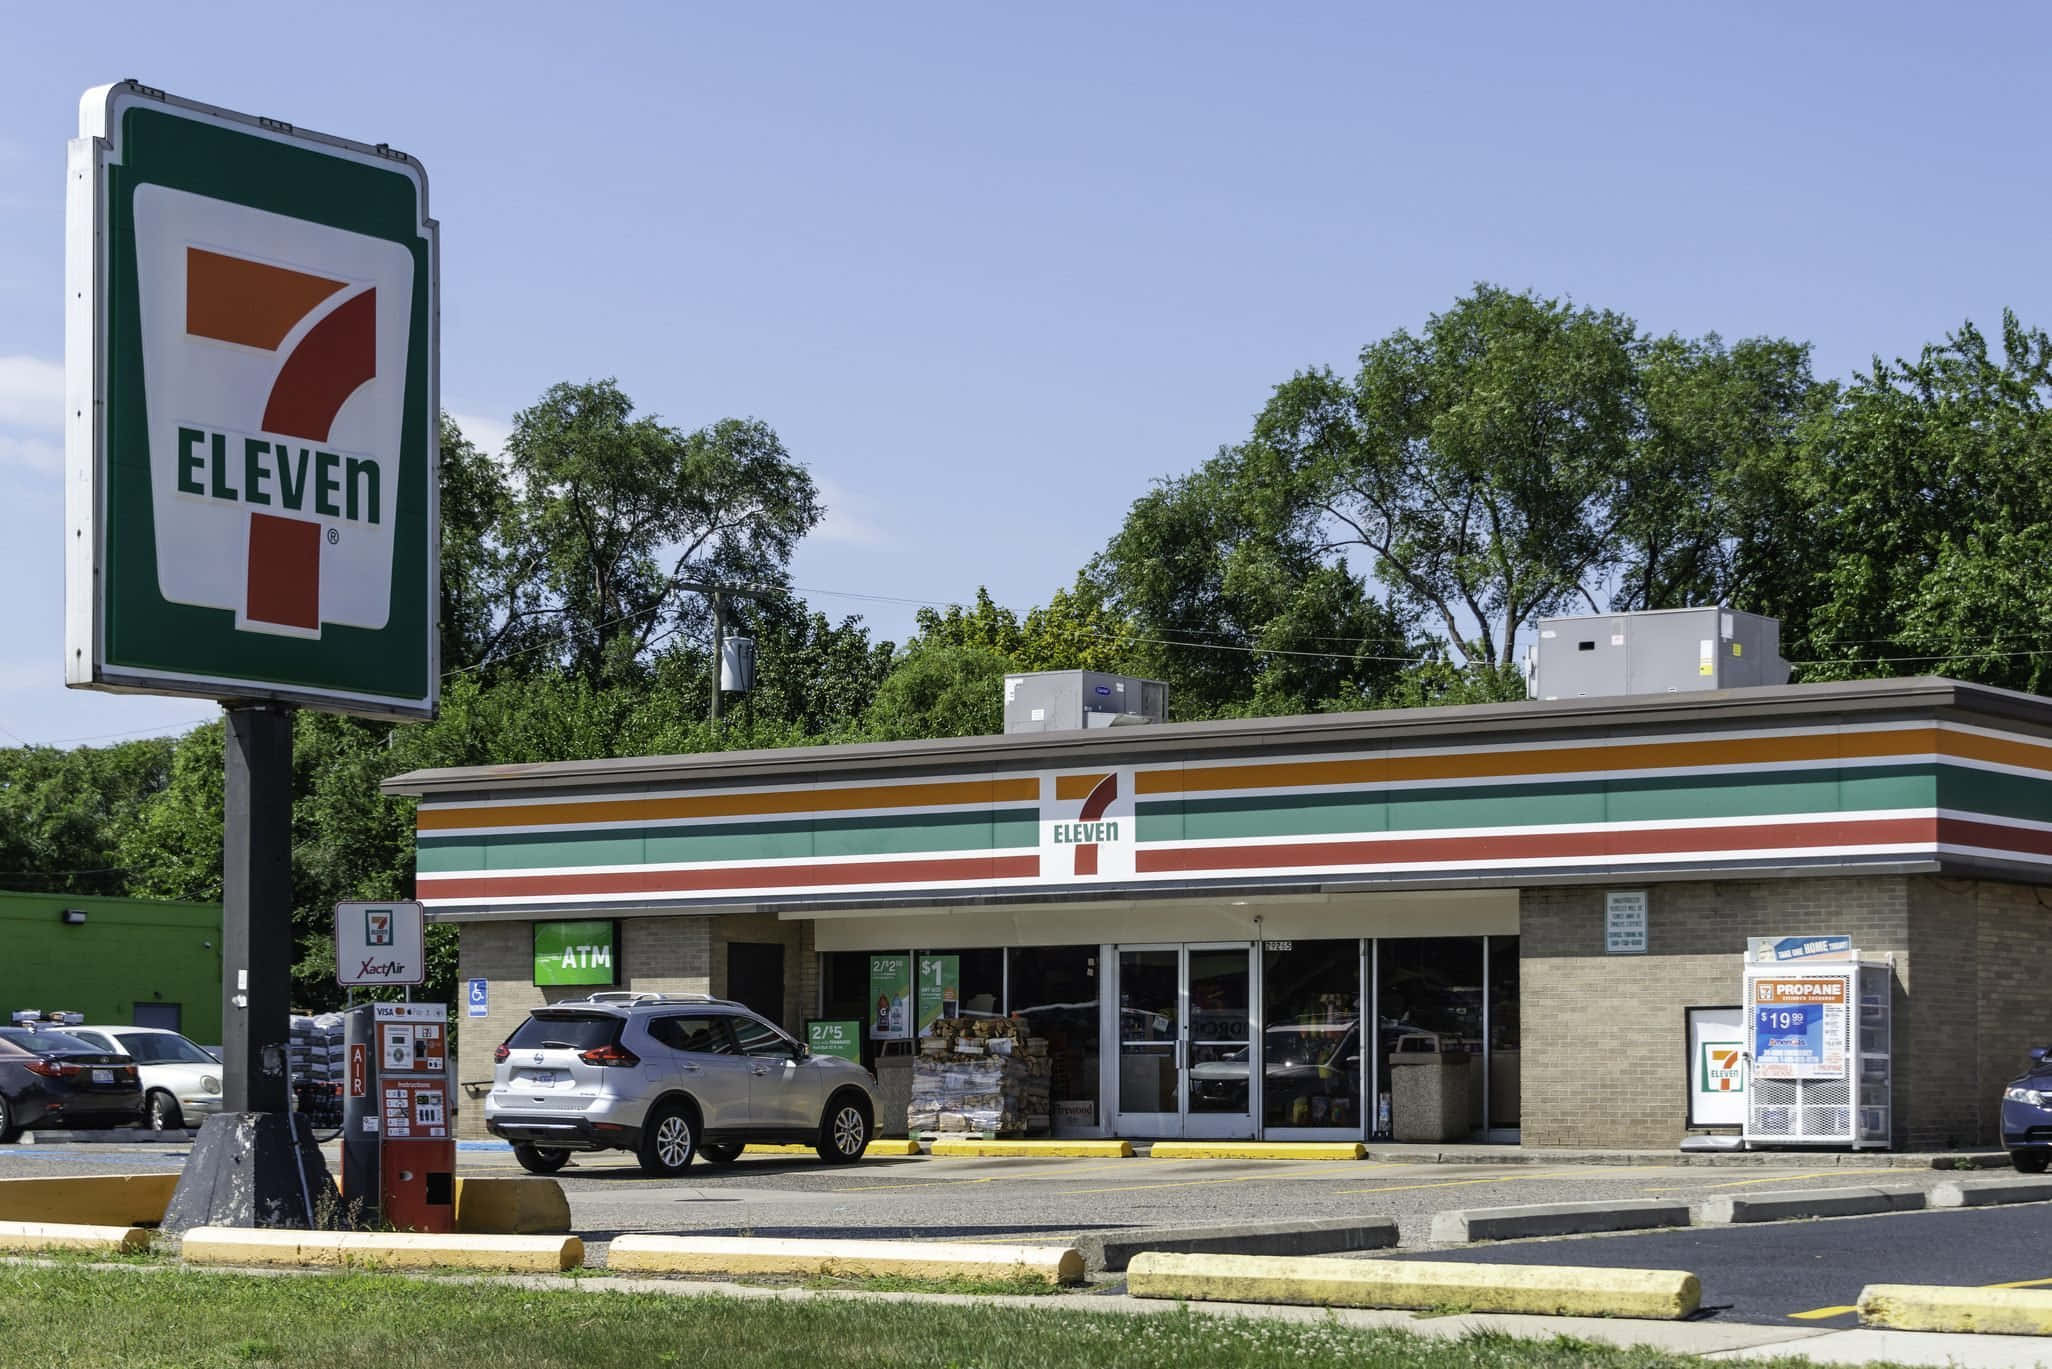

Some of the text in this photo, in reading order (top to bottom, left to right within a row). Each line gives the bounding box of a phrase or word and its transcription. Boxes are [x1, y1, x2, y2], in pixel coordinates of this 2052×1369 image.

[186, 246, 377, 631] 7
[1056, 772, 1118, 876] 7
[561, 945, 611, 969] ATM
[1803, 940, 1829, 954] HOME
[356, 956, 406, 979] XactAir
[921, 959, 942, 986] $1
[1776, 983, 1842, 996] PROPANE
[376, 1007, 394, 1017] VISA
[353, 1047, 363, 1094] AIR
[1711, 1050, 1738, 1091] 7
